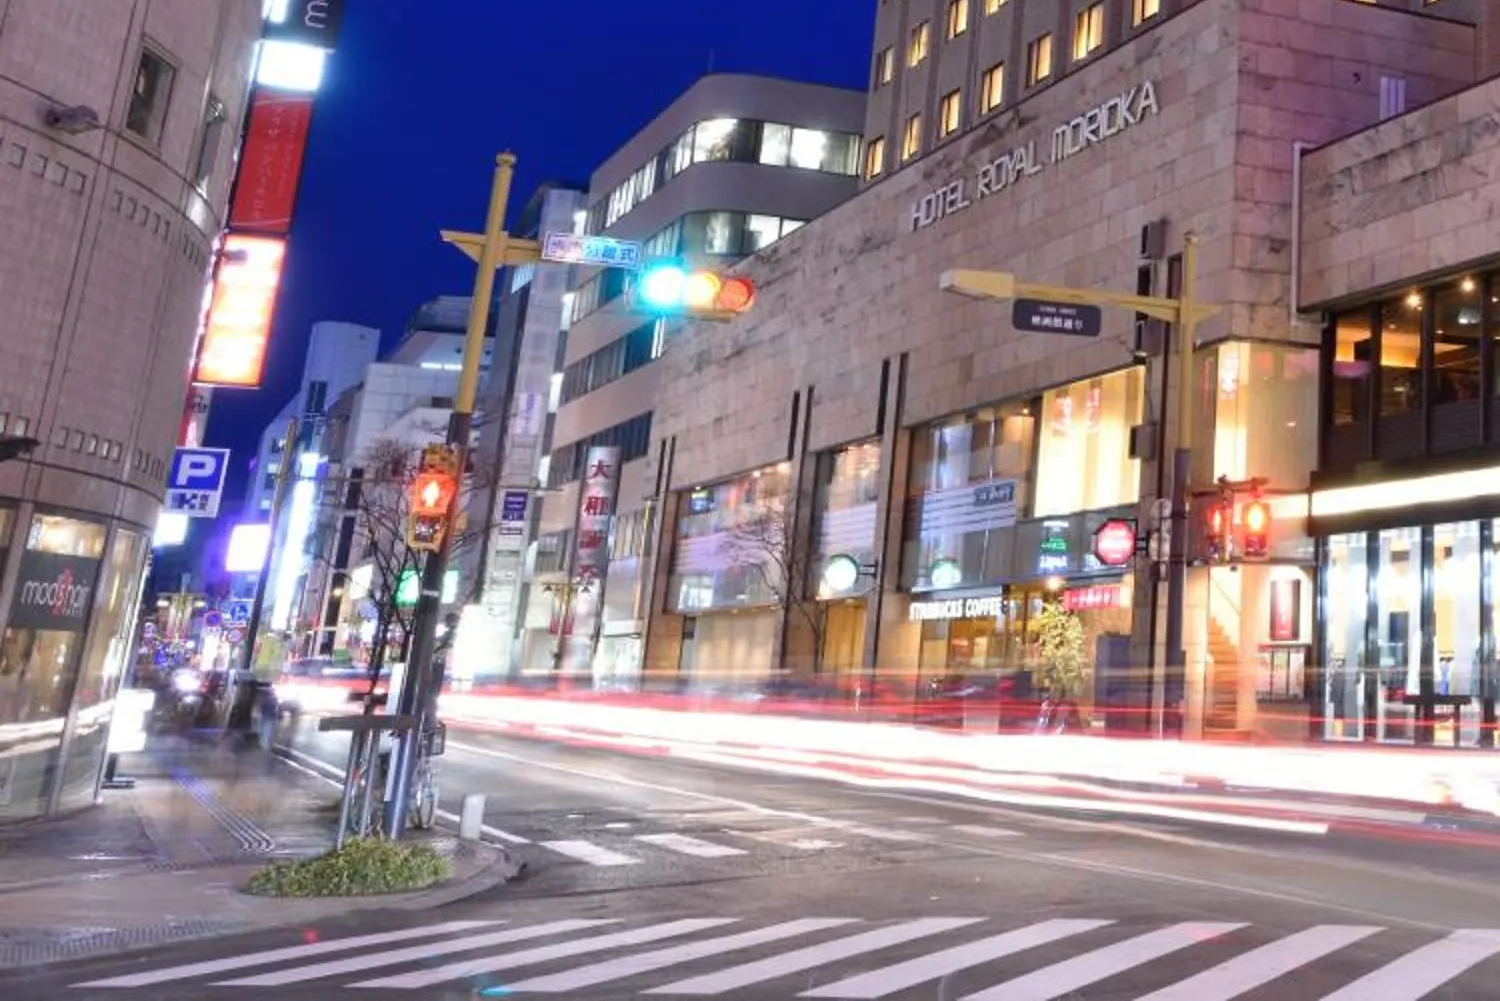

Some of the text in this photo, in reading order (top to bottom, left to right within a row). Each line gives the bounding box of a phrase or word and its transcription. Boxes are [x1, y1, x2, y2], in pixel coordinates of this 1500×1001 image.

[910, 79, 1159, 232] HOTEL ROYAL MORIOKA
[175, 454, 217, 486] P
